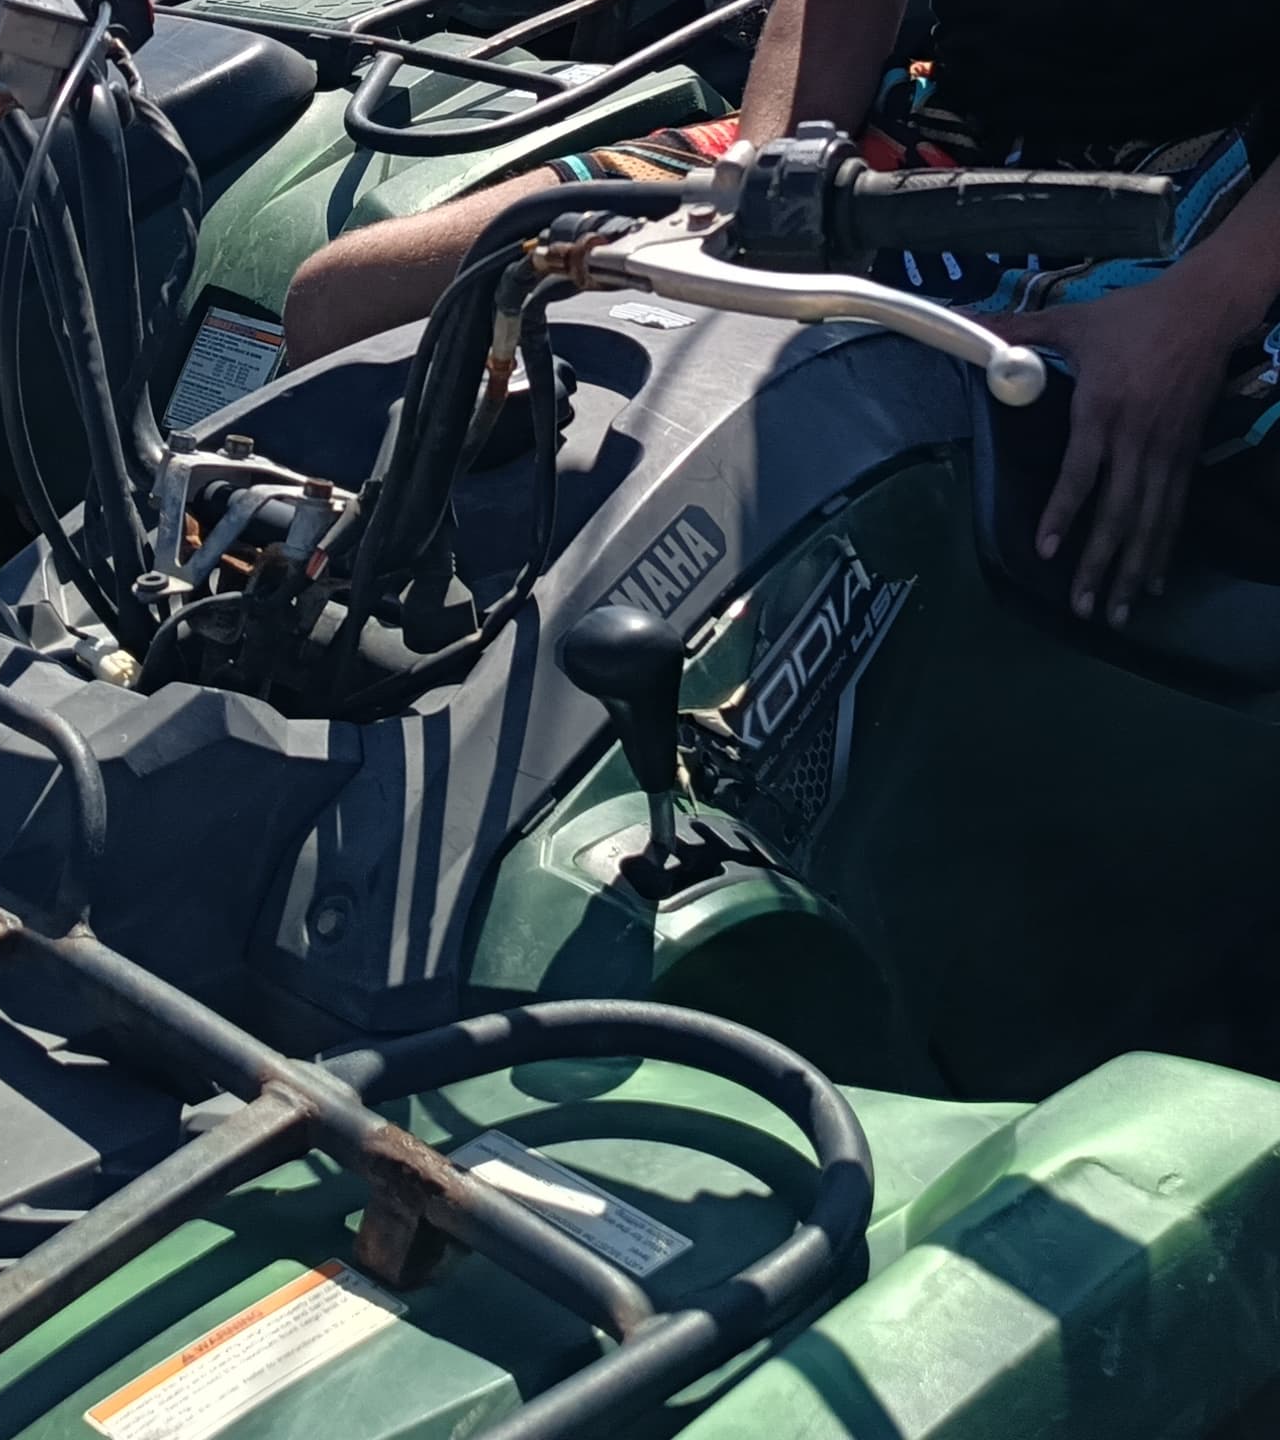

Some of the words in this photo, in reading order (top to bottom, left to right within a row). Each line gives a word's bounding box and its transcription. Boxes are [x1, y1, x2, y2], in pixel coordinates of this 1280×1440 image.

[607, 518, 719, 617] MAHA
[742, 567, 864, 751] KODIA
[194, 1310, 264, 1358] WARNING
